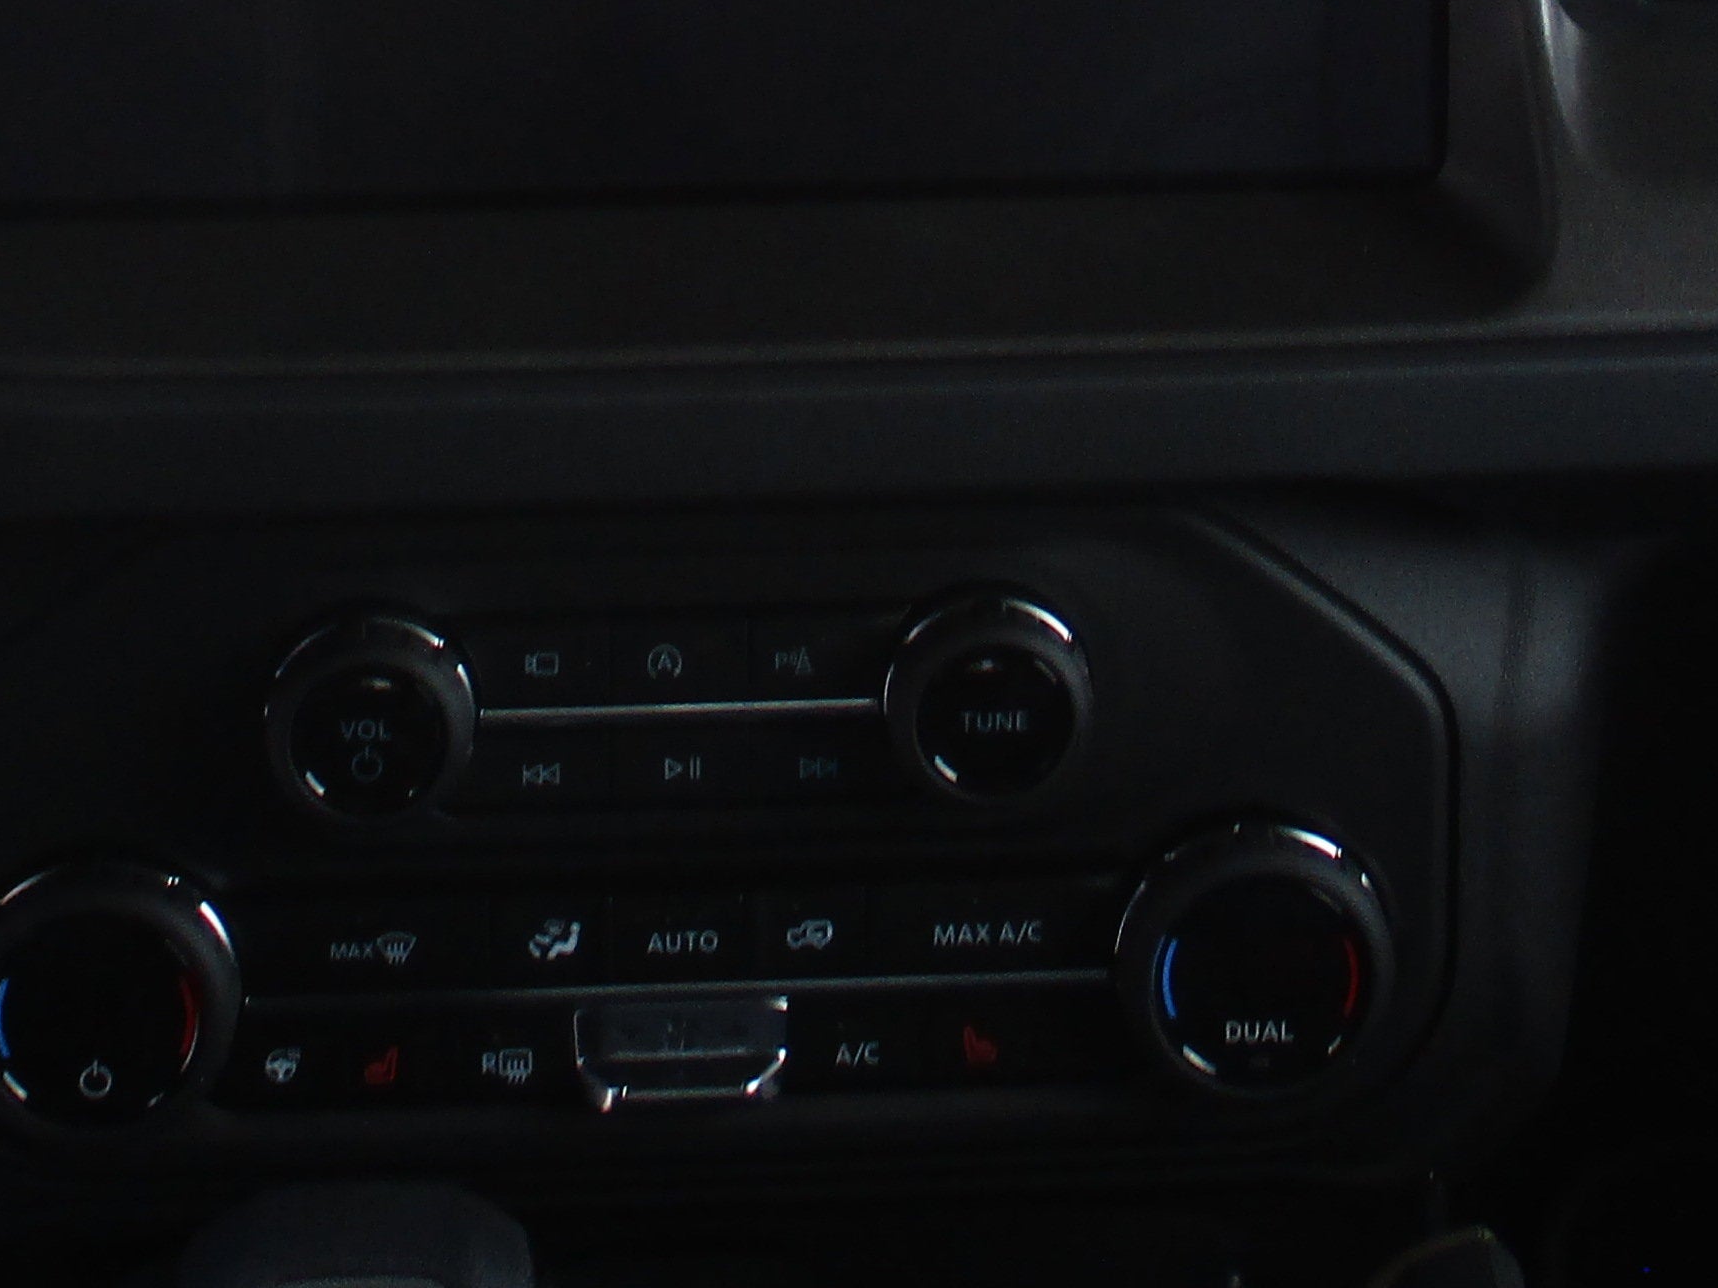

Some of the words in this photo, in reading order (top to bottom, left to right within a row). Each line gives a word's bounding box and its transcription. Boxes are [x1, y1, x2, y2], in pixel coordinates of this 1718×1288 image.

[339, 718, 392, 742] VOL
[961, 709, 1029, 734] TUNE
[647, 929, 718, 954] AUTO
[933, 922, 991, 946] MAX
[998, 920, 1043, 945] A/C
[330, 942, 374, 960] MAX
[1225, 1018, 1294, 1043] DUAL
[835, 1040, 880, 1067] A/C
